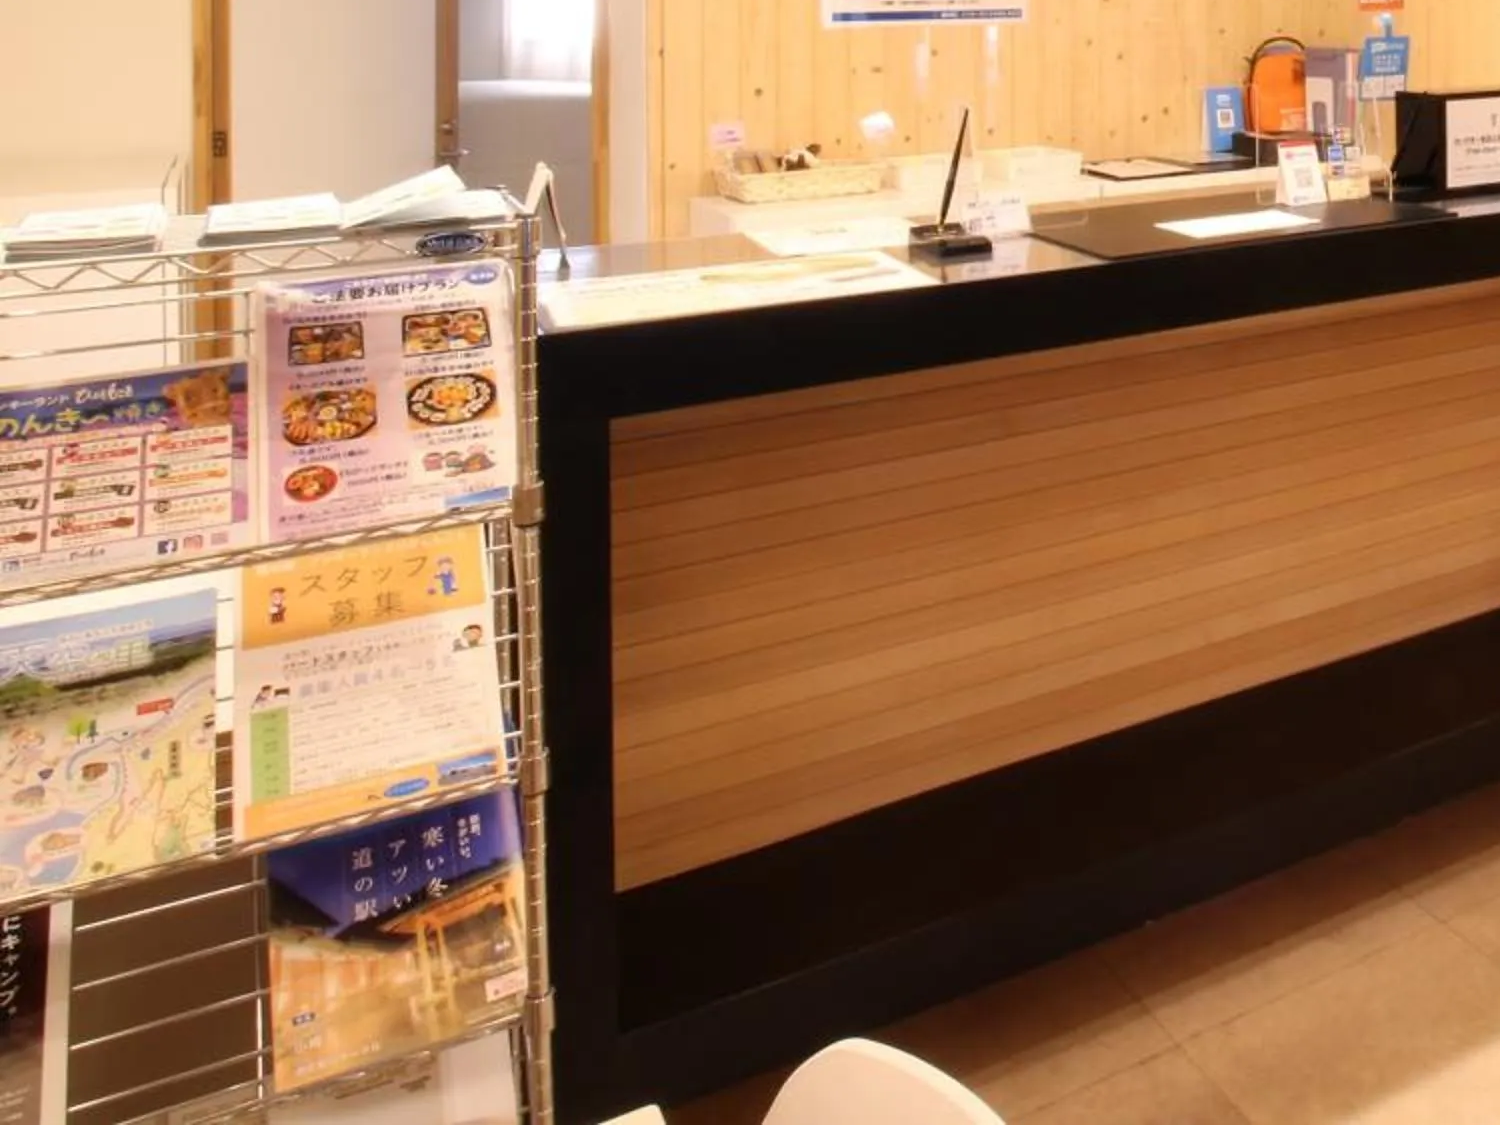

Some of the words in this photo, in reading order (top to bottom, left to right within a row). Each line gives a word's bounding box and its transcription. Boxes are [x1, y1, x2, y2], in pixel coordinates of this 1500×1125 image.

[300, 556, 428, 597] スタッフ
[328, 592, 405, 627] 募集
[352, 847, 379, 921] 道の駅
[388, 839, 412, 909] アツい
[422, 826, 448, 897] 寒い冬
